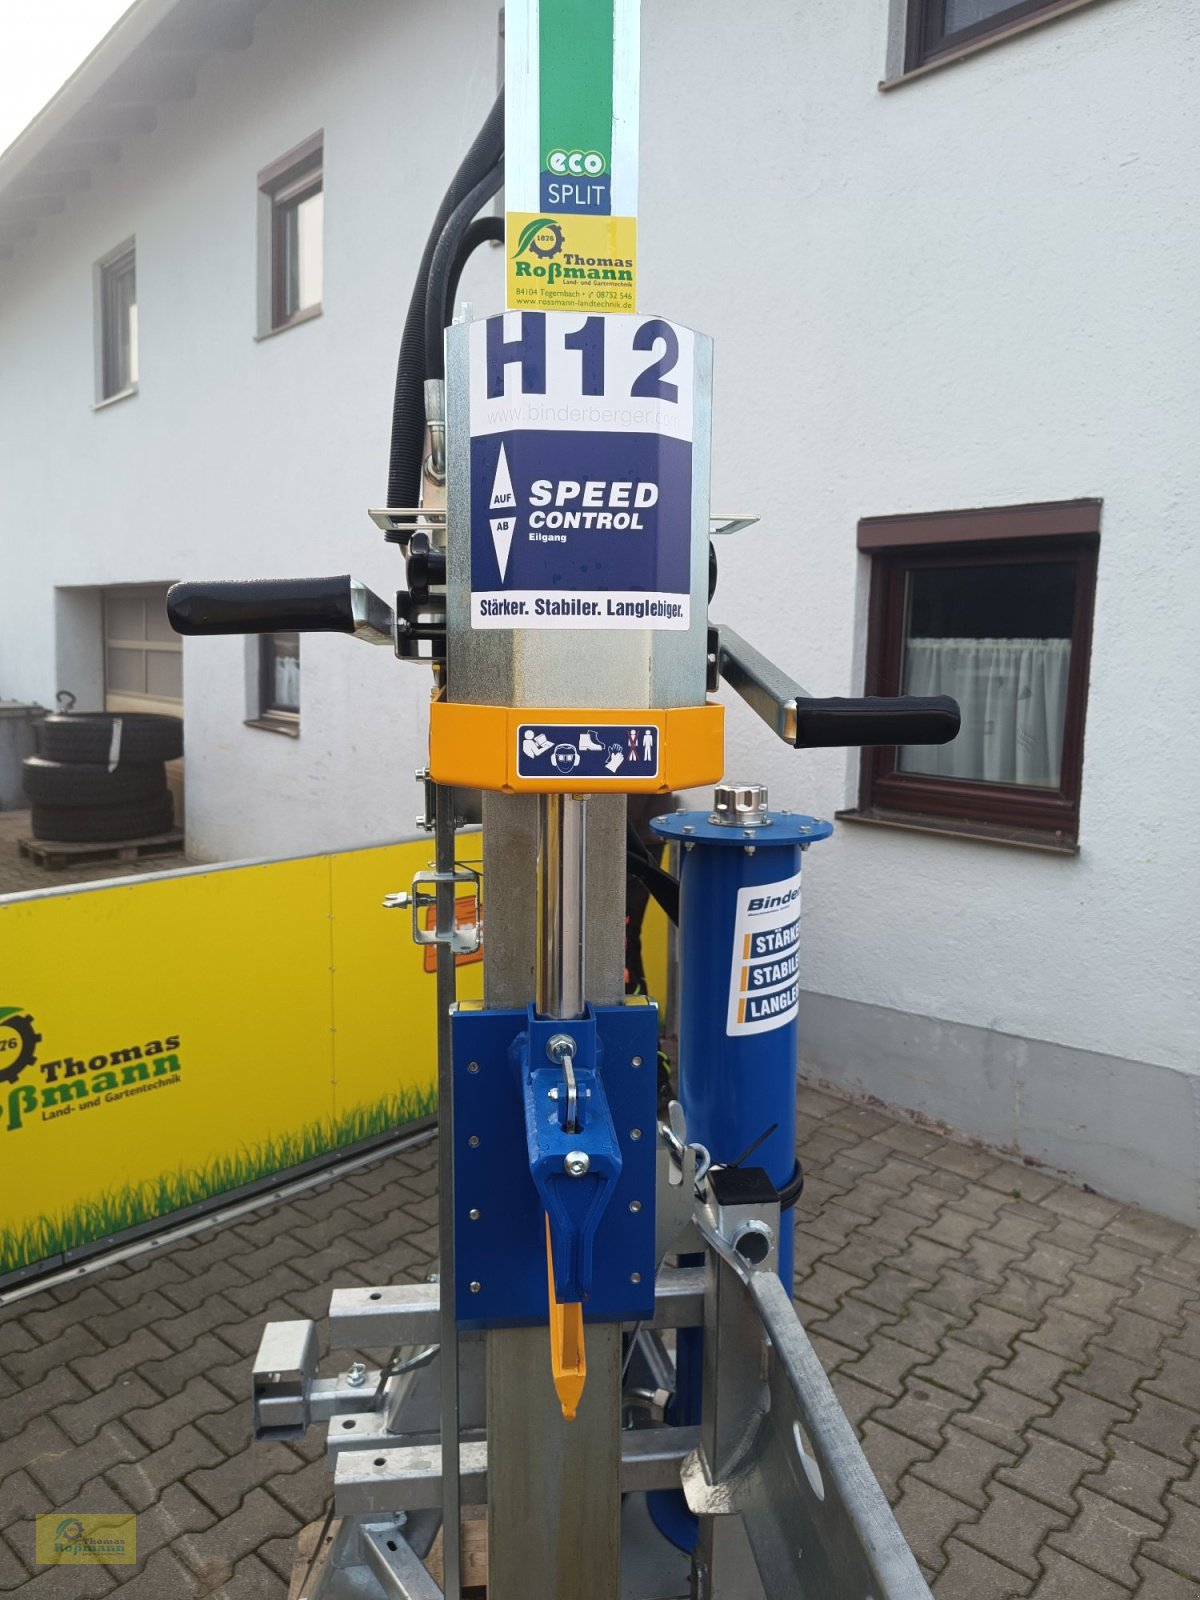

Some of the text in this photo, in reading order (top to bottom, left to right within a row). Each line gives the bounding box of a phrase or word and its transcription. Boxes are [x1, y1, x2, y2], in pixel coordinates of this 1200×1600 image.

[550, 152, 602, 174] eco
[548, 183, 605, 205] SPLIT
[563, 254, 633, 267] Thomas
[515, 261, 633, 284] Roßmann
[540, 288, 580, 298] Tegernbach
[596, 291, 618, 299] 08752
[619, 292, 632, 300] 546
[593, 280, 633, 288] Gartentechnik
[486, 311, 679, 404] H12
[494, 493, 512, 504] AUF
[528, 479, 659, 508] SPEED
[496, 521, 509, 531] AB
[528, 511, 644, 530] CONTROL
[528, 532, 567, 543] Eilgang
[480, 598, 684, 619] Stärker. Stabiler. Langlebiger.
[40, 1034, 181, 1083] Thomas
[0, 1053, 182, 1131] ßmann
[42, 1075, 182, 1121] Land- und Gartentechnik
